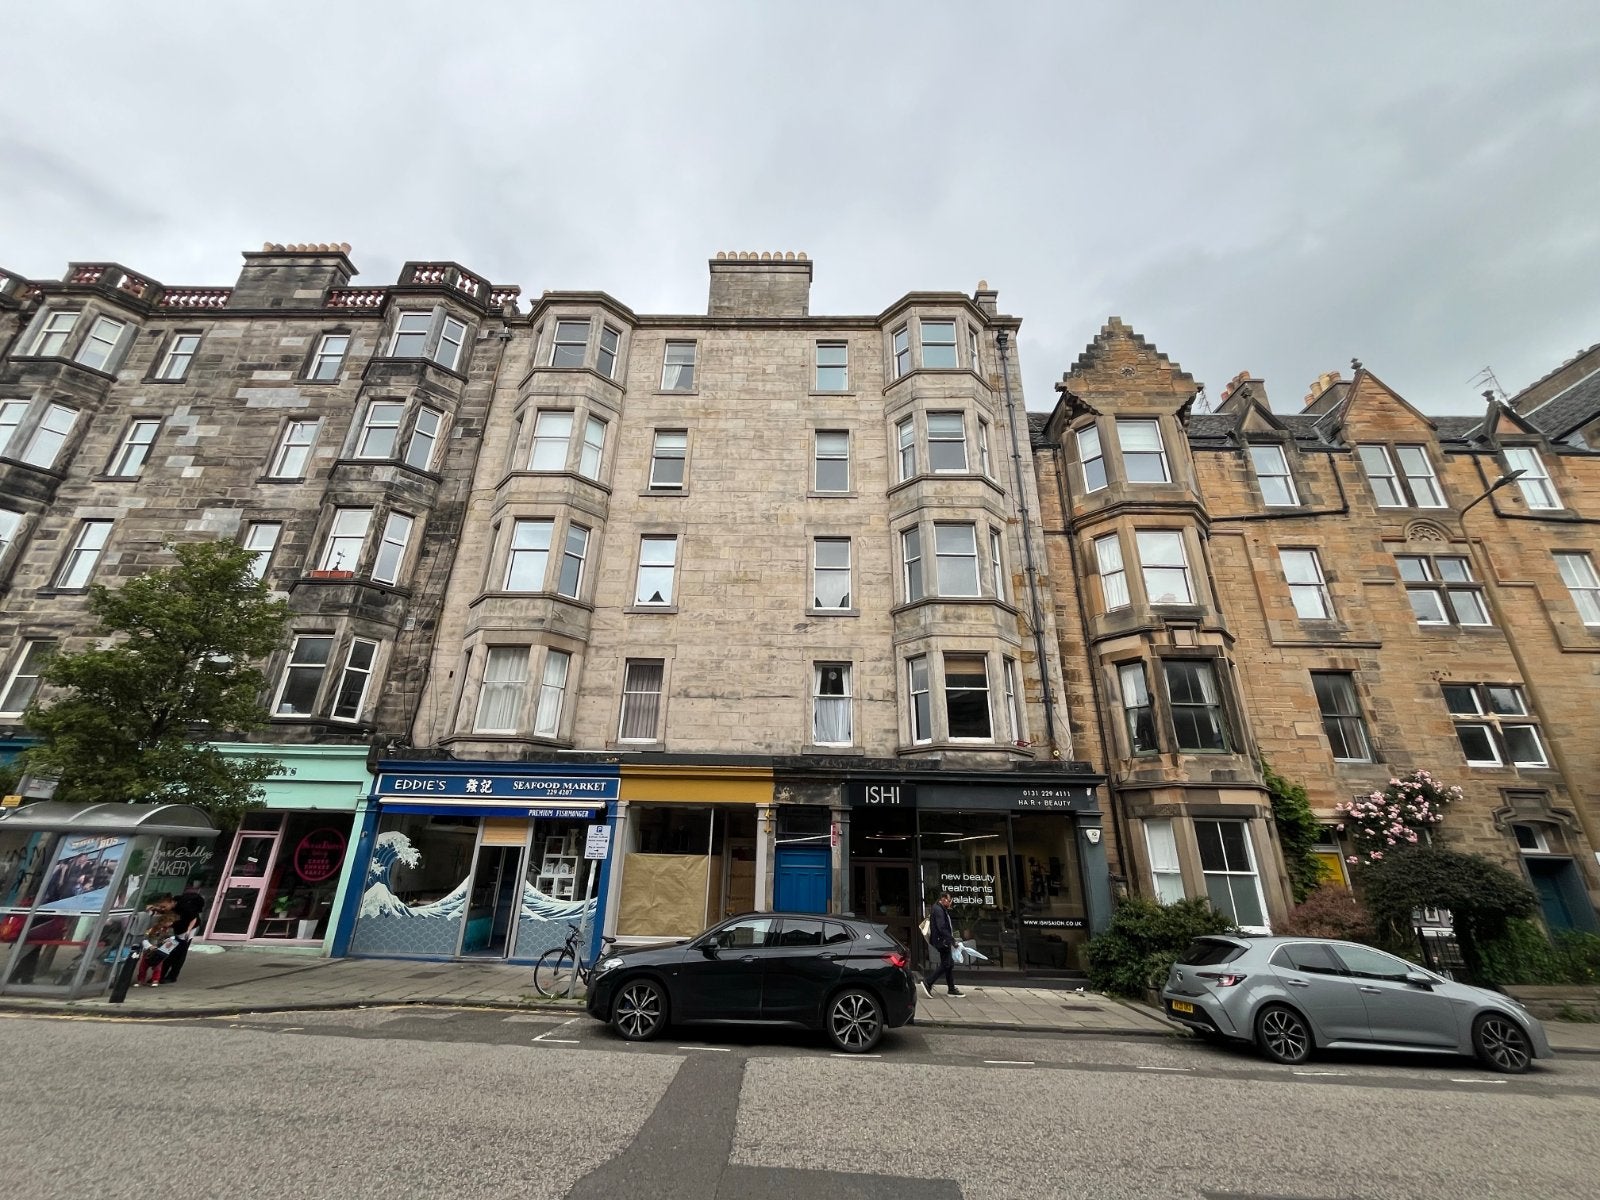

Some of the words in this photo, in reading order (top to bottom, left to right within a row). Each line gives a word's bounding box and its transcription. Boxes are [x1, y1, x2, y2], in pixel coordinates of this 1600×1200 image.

[394, 779, 447, 791] EDDIE'S
[513, 781, 561, 791] SEAFOOD
[563, 782, 608, 792] MARKET
[865, 786, 900, 804] ISHI
[528, 809, 554, 818] PREMIUM
[556, 810, 590, 819] FISHMONGER
[150, 860, 197, 876] BAKERY
[941, 873, 961, 881] new
[963, 872, 996, 884] beauty
[941, 883, 993, 893] treatments
[951, 895, 983, 904] vailable
